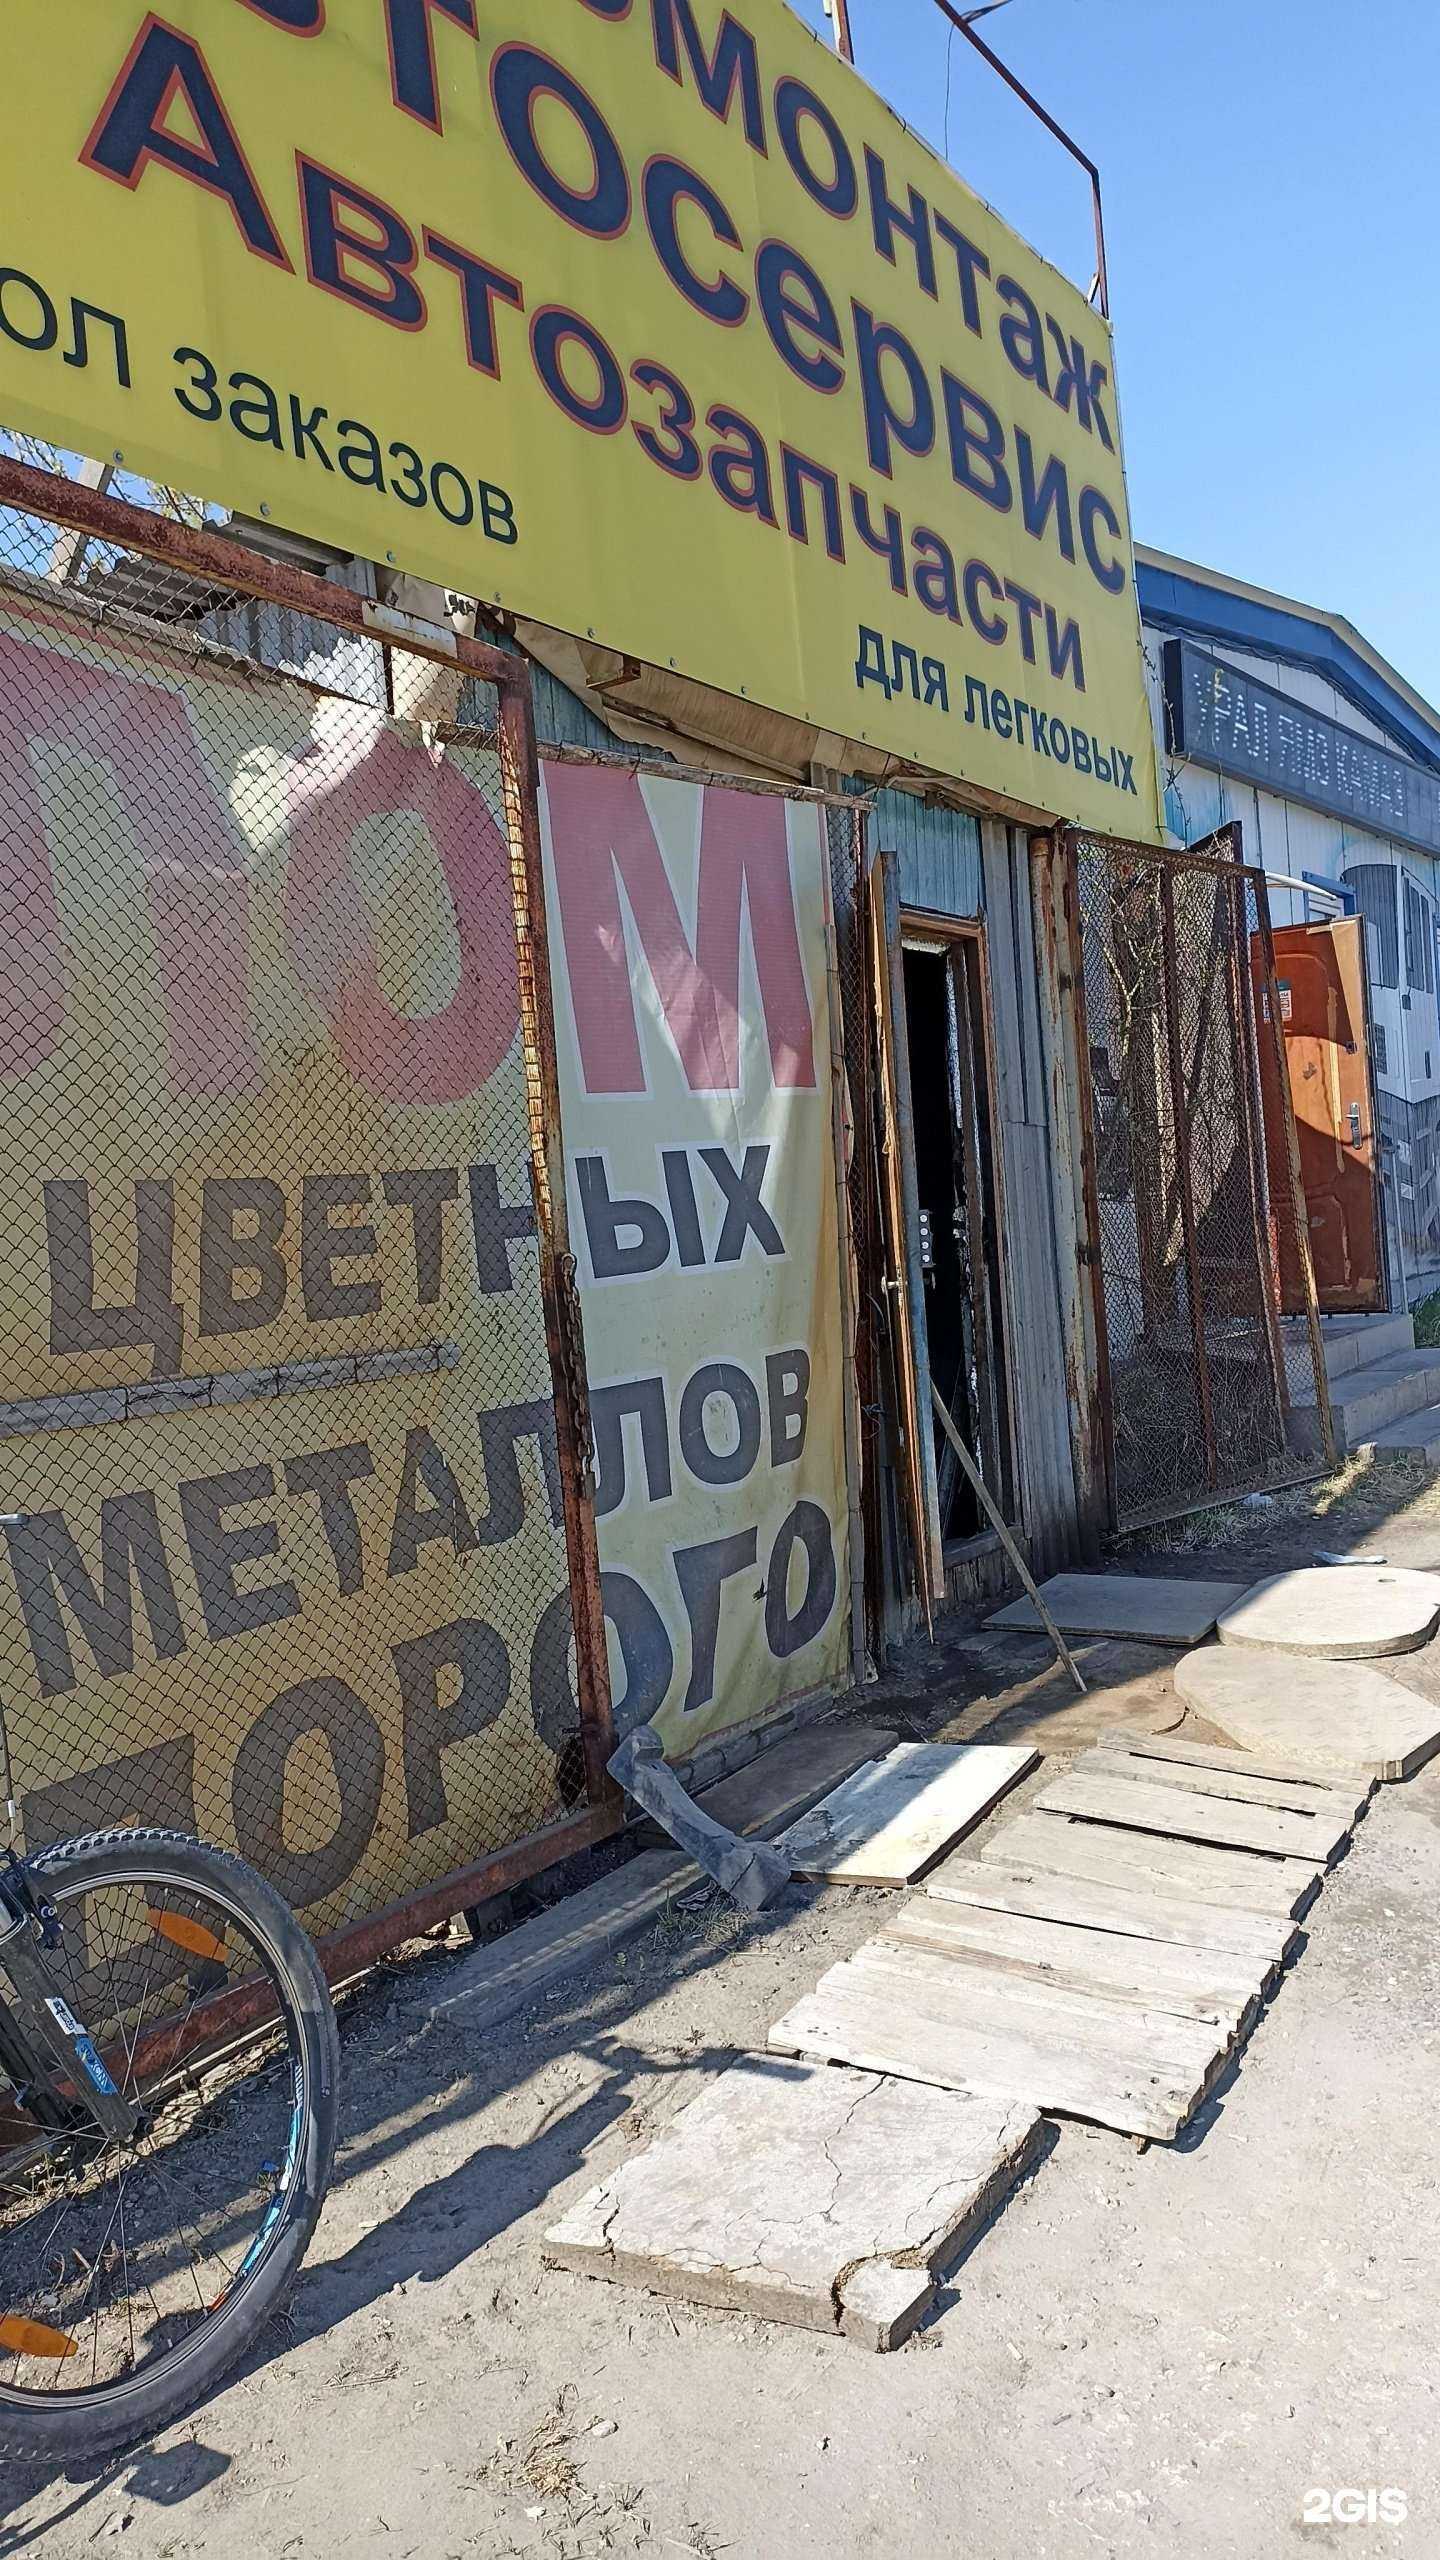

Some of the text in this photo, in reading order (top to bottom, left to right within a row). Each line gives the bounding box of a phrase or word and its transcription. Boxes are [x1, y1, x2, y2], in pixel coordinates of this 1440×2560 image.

[78, 11, 1087, 692] Автозапчасти
[575, 0, 1115, 455] монтаж
[173, 347, 517, 545] заказов
[855, 624, 1138, 796] для легковых
[43, 1145, 785, 1378] ЦВЕТНЫХ
[5, 1348, 811, 1698] МЕТАЛЛОВ
